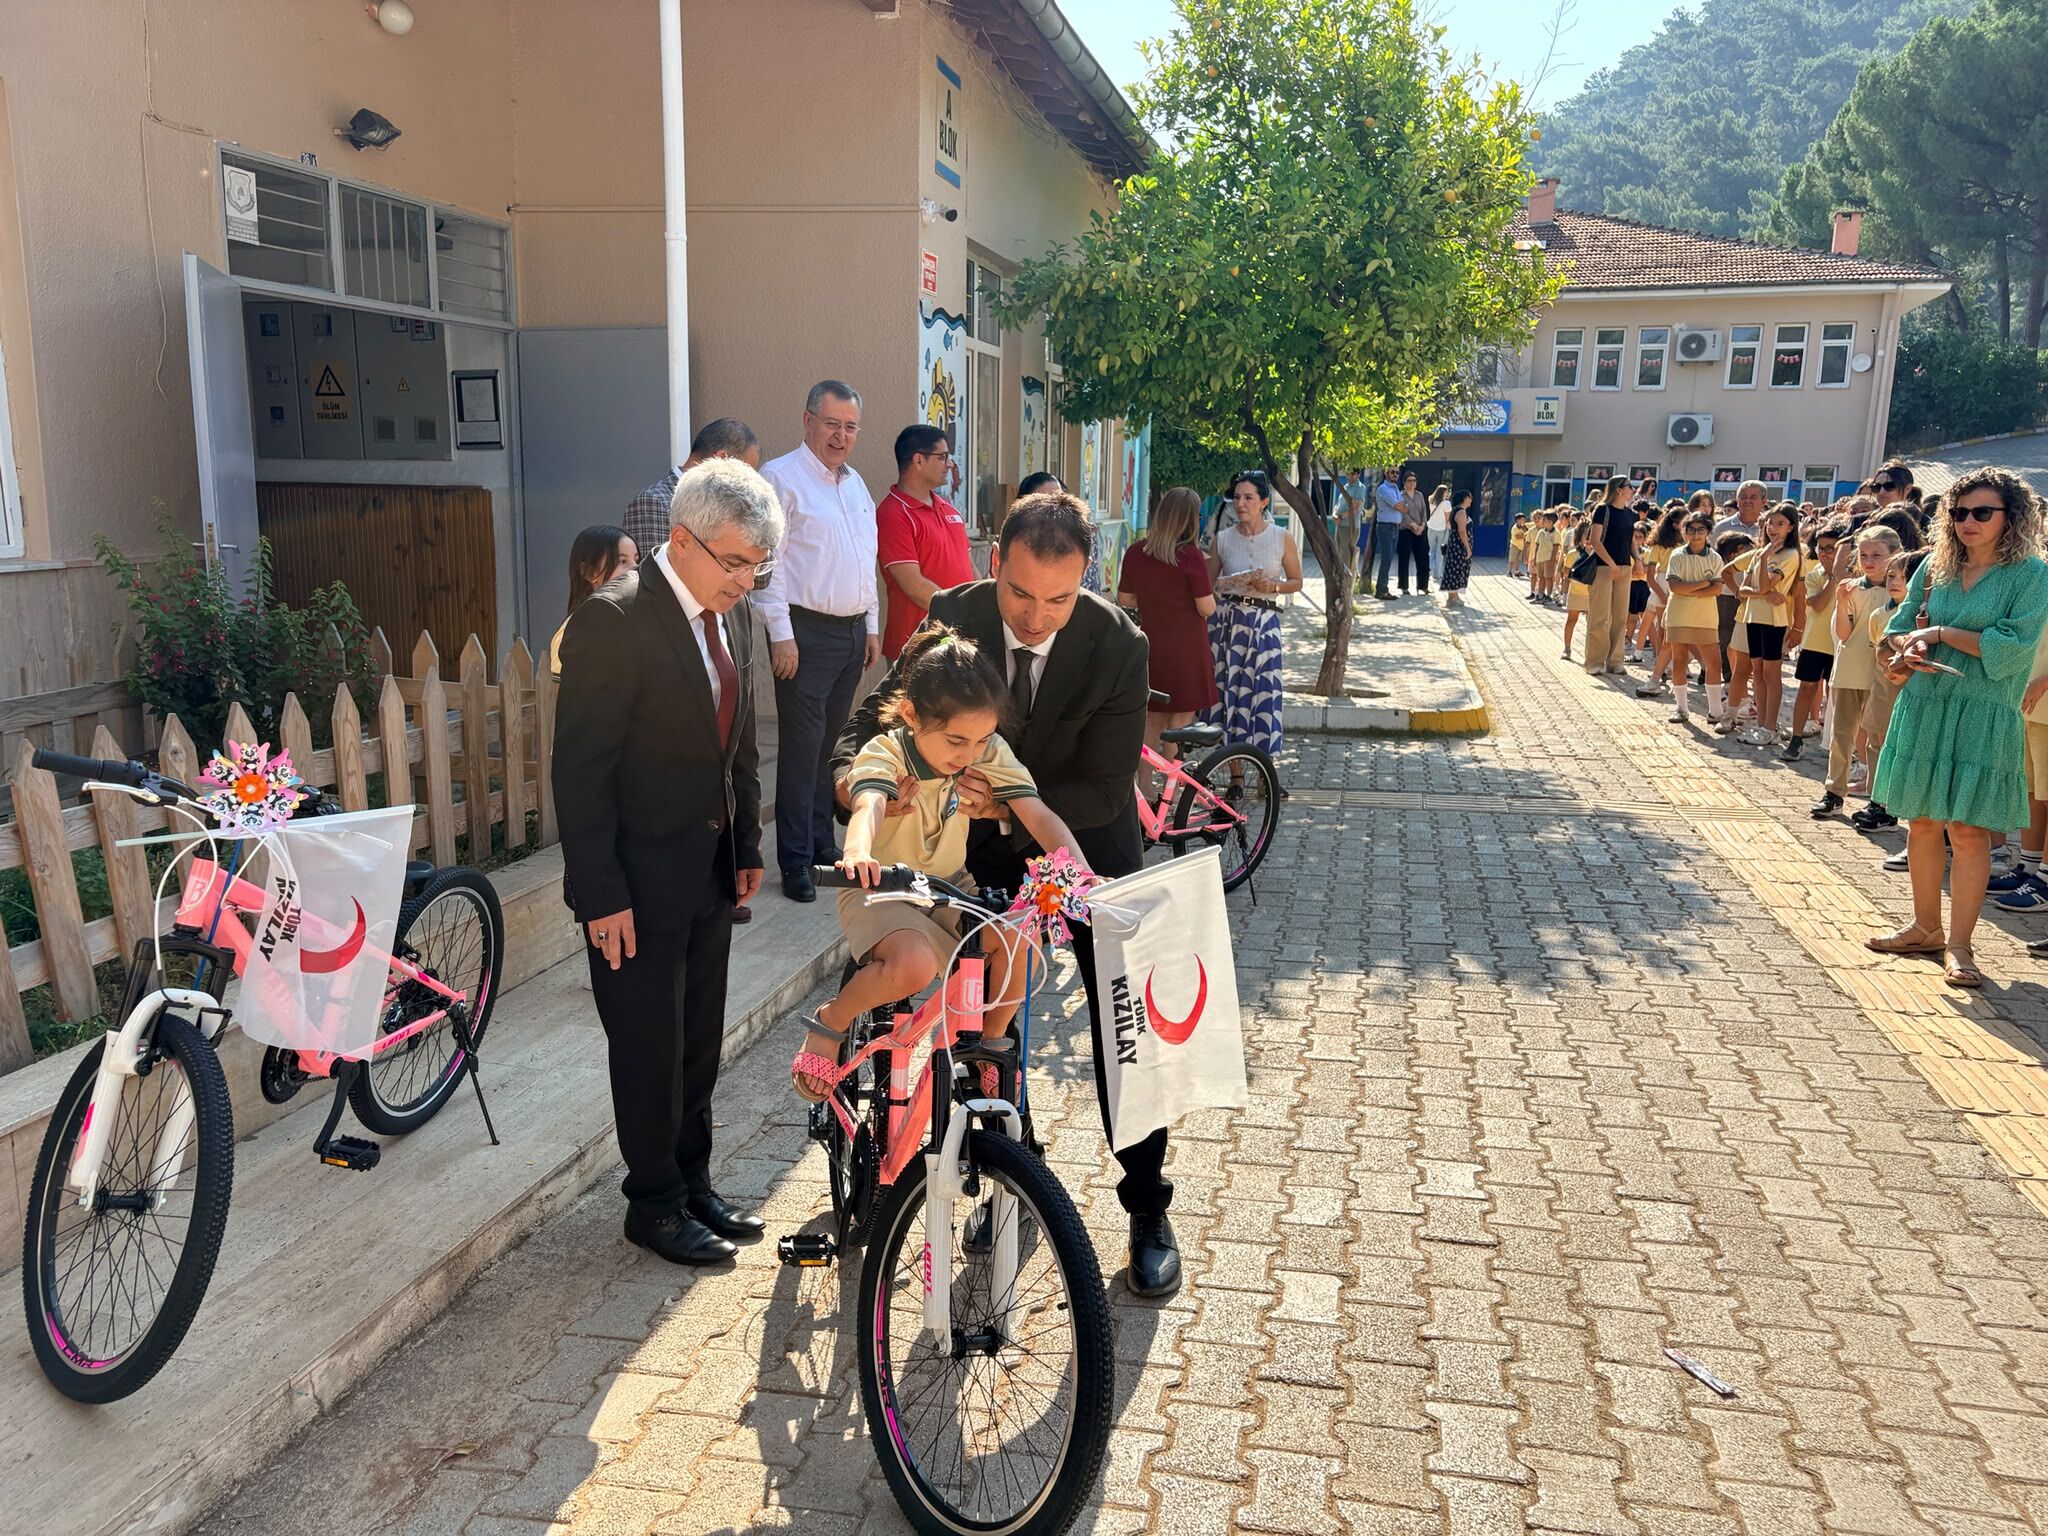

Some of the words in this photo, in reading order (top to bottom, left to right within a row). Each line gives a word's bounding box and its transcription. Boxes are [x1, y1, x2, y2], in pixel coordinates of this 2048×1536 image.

[945, 89, 952, 121] A
[939, 119, 958, 162] BLOK
[1536, 411, 1555, 420] BLOK
[280, 907, 302, 944] TÜRK
[1110, 974, 1138, 1066] KIZILAY
[1133, 996, 1147, 1036] TÜRK
